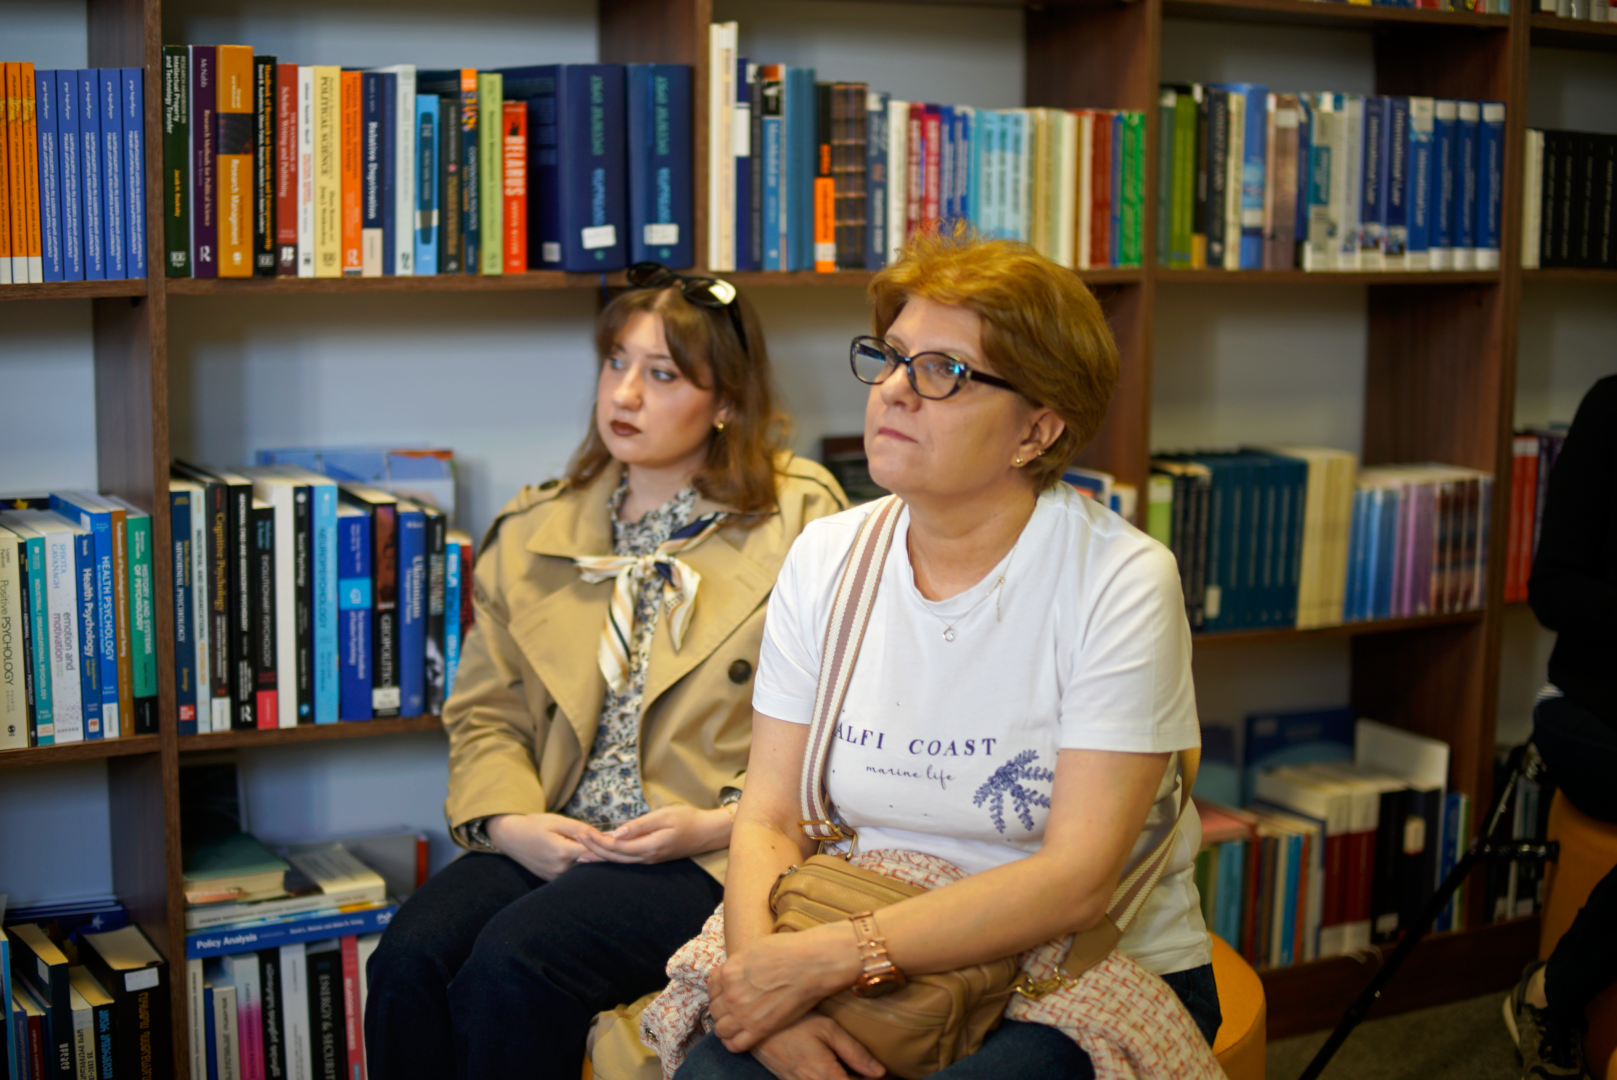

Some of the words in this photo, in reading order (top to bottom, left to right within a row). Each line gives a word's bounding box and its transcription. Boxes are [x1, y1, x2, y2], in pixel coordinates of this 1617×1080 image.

[164, 69, 173, 106] Technology
[200, 58, 208, 88] McNabb
[280, 86, 289, 118] Scholarly
[321, 77, 329, 129] POLITICAL
[280, 120, 289, 142] Writing
[368, 122, 377, 161] Relative
[280, 144, 289, 159] and
[321, 133, 329, 177] SCIENCE
[505, 136, 525, 196] BELARUS
[204, 177, 212, 202] Political
[231, 159, 240, 193] Research
[279, 161, 289, 198] Publishing
[367, 163, 377, 219] Deprivation
[229, 195, 240, 245] Management
[213, 512, 225, 558] Cognitive
[51, 543, 60, 589] CAVANAGH
[59, 543, 67, 574] SHIOTA
[101, 556, 111, 594] HEALTH
[134, 564, 142, 576] OF
[175, 540, 183, 587] ABNORMAL
[0, 579, 10, 615] Positive
[83, 568, 92, 601] Health
[214, 560, 226, 612] Psychology
[262, 554, 270, 614] EVOLUTIONARY
[412, 555, 423, 618] Ukrainians
[135, 578, 143, 631] PSYCHOLOGY
[176, 588, 185, 643] PSYCHOLOGY
[53, 613, 64, 662] motivation
[64, 612, 74, 650] emotion
[83, 602, 95, 657] Psychology
[103, 596, 114, 661] PSYCHOLOGY
[263, 614, 271, 667] PSYCHOLOGY
[2, 616, 14, 686] PSYCHOLOGY
[65, 653, 76, 670] and
[908, 738, 997, 756] COAST
[866, 764, 922, 779] marine
[927, 764, 957, 790] life
[196, 939, 221, 950] Policy
[223, 932, 258, 946] Analysis
[318, 974, 333, 1019] ENERGY
[321, 1021, 334, 1032] &
